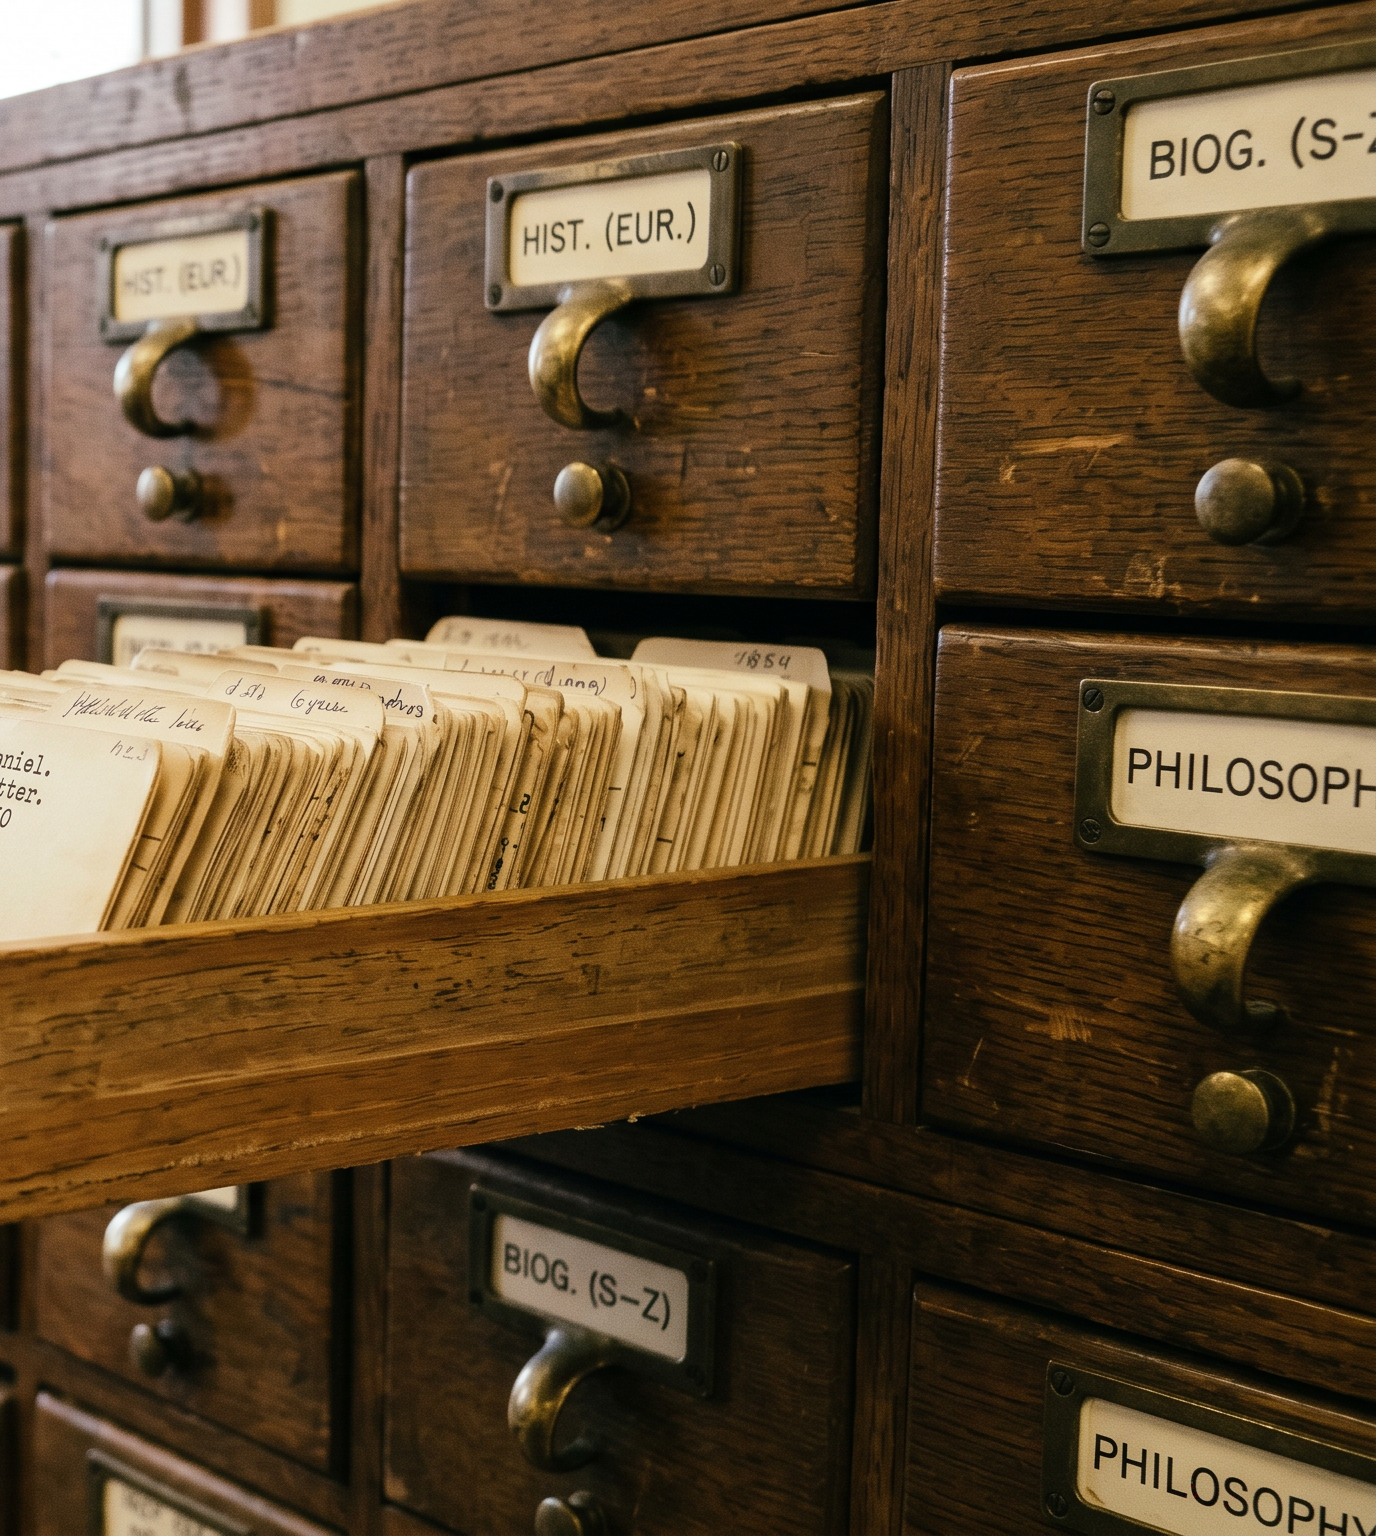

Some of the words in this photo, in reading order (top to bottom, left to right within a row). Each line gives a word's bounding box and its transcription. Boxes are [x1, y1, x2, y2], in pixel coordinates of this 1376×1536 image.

[1149, 128, 1266, 181] BIOG.
[523, 218, 591, 257] HIST.
[605, 201, 697, 253] (EUR.)
[503, 1242, 577, 1296] BIOG.
[589, 1269, 672, 1332] (S-Z)
